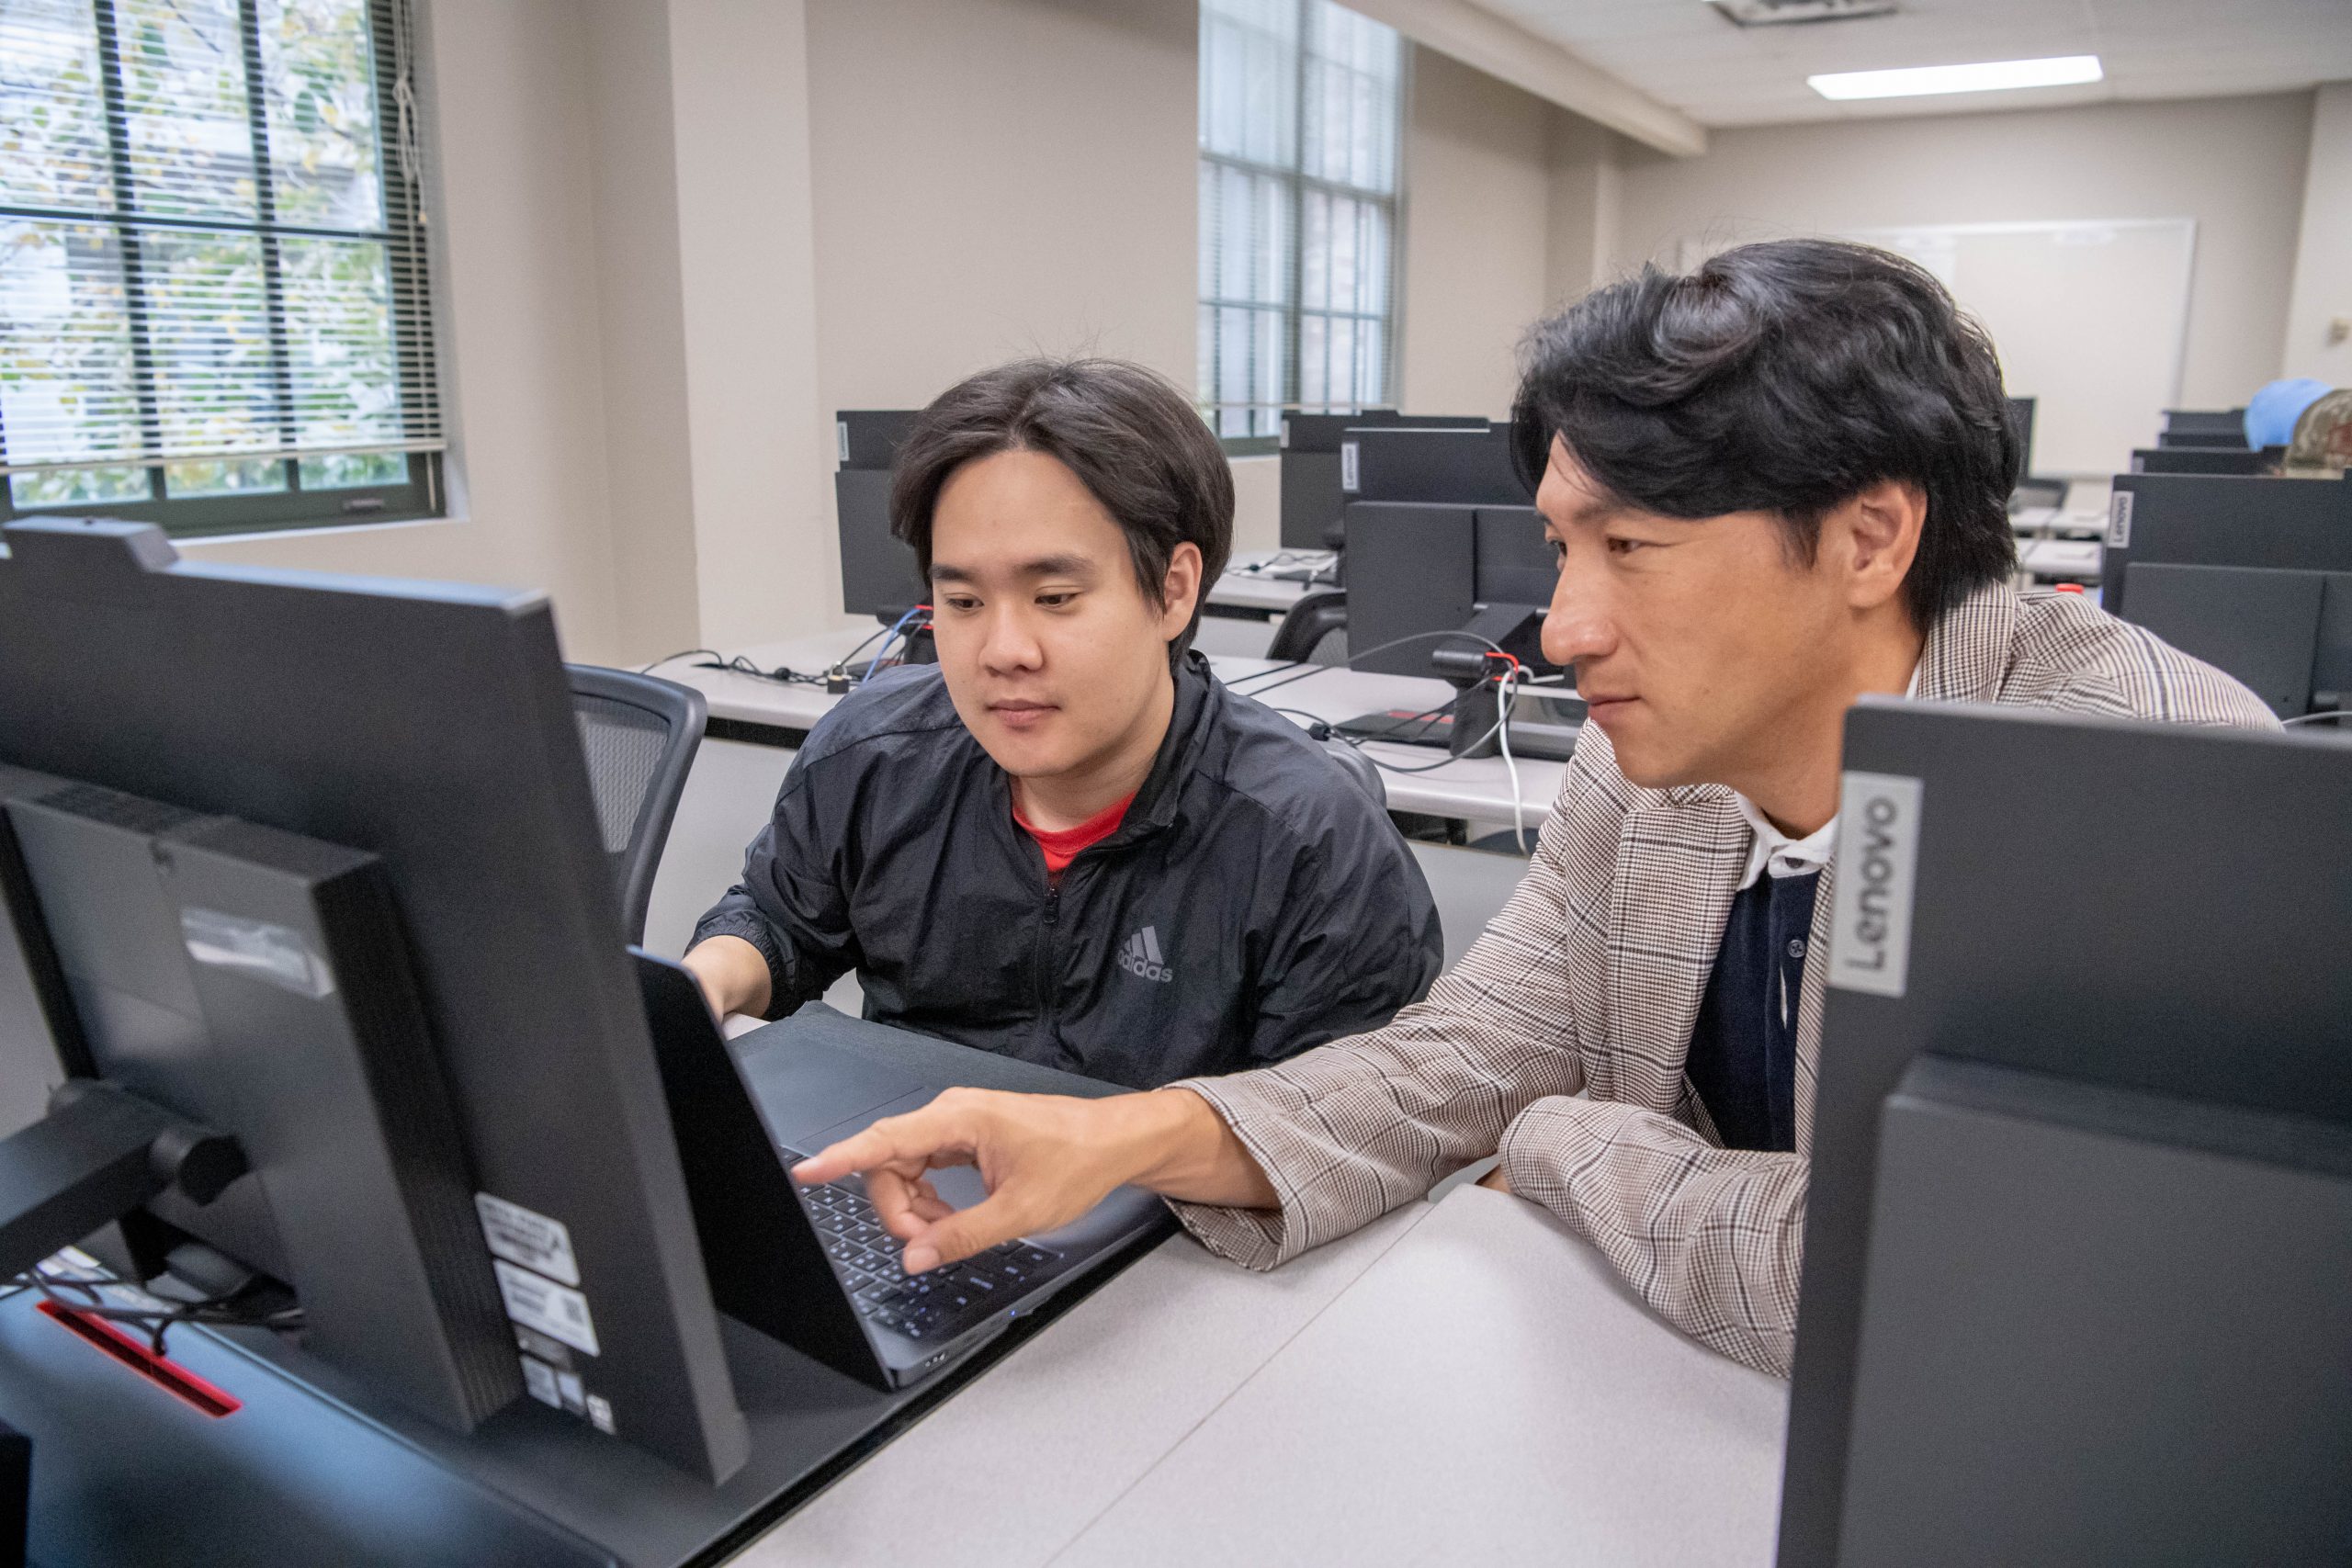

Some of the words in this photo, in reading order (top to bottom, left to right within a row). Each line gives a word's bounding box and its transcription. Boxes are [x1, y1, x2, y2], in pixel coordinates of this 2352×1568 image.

[2114, 496, 2128, 543] Lenovo
[1844, 795, 1896, 971] Lenovo
[1117, 949, 1173, 983] adidas
